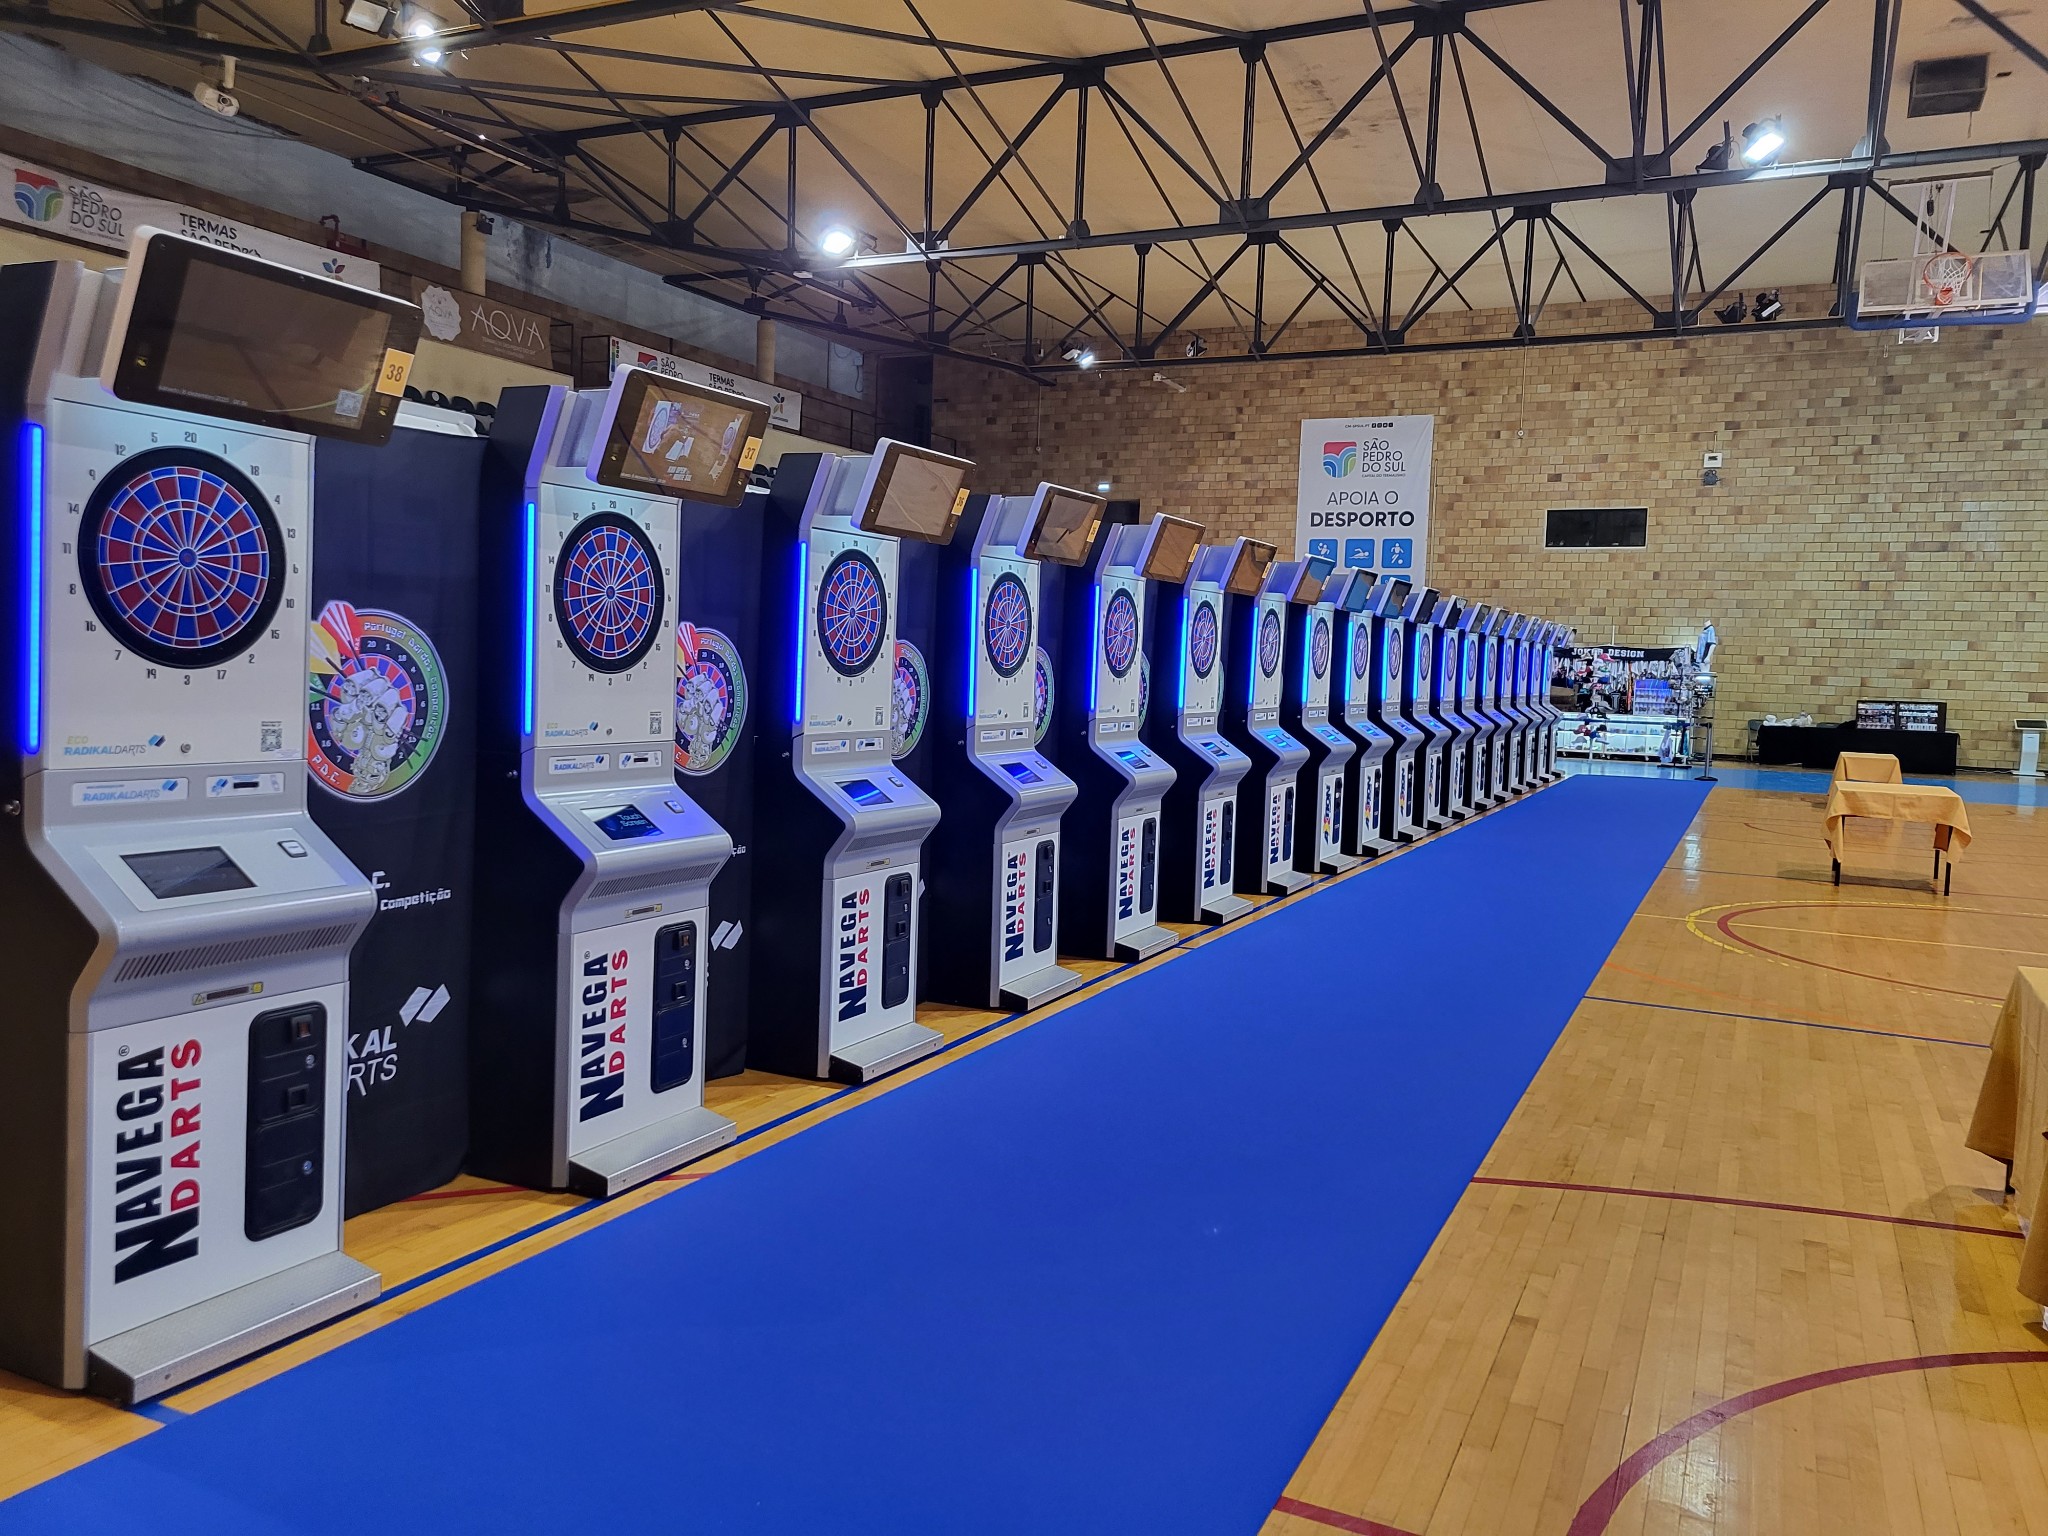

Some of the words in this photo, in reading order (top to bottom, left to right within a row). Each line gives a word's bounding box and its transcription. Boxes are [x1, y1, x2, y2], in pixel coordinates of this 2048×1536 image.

[68, 185, 103, 203] SÃO
[72, 197, 122, 221] PEDRO
[70, 212, 96, 228] DO
[99, 219, 125, 237] SUL
[180, 212, 238, 239] TERMAS
[470, 304, 544, 350] AQVA
[661, 357, 676, 370] SÃO
[387, 364, 403, 382] 38
[709, 372, 735, 387] TERMAS
[151, 432, 158, 443] 5
[185, 431, 197, 443] 20
[115, 444, 126, 456] 12
[223, 444, 227, 454] 1
[1363, 438, 1389, 451] SÃO
[746, 448, 756, 459] 37
[1363, 451, 1403, 462] PEDRO
[250, 465, 259, 476] 18
[1362, 462, 1381, 473] DO
[1384, 461, 1406, 473] SUL
[89, 469, 95, 480] 9
[274, 495, 280, 504] 4
[1327, 491, 1379, 505] APOIA
[1384, 490, 1399, 505] O
[68, 503, 79, 514] 14
[592, 502, 595, 510] 5
[609, 500, 616, 509] 20
[573, 512, 579, 521] 12
[630, 508, 633, 516] 1
[1310, 511, 1415, 527] DESPORTO
[287, 528, 296, 538] 13
[559, 531, 563, 539] 9
[62, 543, 71, 554] 11
[548, 556, 554, 564] 14
[293, 564, 298, 574] 6
[665, 568, 670, 576] 13
[69, 584, 76, 594] 8
[545, 584, 550, 593] 11
[286, 598, 294, 608] 10
[549, 614, 552, 622] 8
[85, 621, 96, 632] 16
[664, 620, 669, 628] 10
[271, 629, 280, 639] 15
[367, 640, 376, 648] 20
[115, 650, 121, 660] 7
[1608, 649, 1645, 657] DESIGN
[249, 654, 255, 664] 2
[572, 660, 576, 668] 7
[146, 669, 156, 679] 19
[217, 670, 227, 679] 17
[184, 675, 190, 685] 3
[608, 678, 612, 686] 3
[545, 726, 589, 737] RADIKALDARTS
[67, 736, 88, 744] ECO
[64, 745, 146, 756] RADIKALDARTS
[554, 761, 595, 771] RADIKALDARTS
[82, 789, 160, 802] RADIKALDARTS
[618, 812, 643, 821] Touch
[620, 818, 648, 827] Screen
[732, 844, 746, 857] ção
[1204, 810, 1214, 889] NAVEGA
[1128, 827, 1136, 896] DARTS
[371, 870, 391, 889] C.
[1119, 829, 1132, 920] NAVEGA
[1017, 852, 1026, 933] DARTS
[380, 887, 451, 912] Competição
[1005, 854, 1024, 962] NAVEGA
[857, 888, 870, 986] DARTS
[838, 891, 867, 1022] NAVEGA
[609, 949, 628, 1073] DARTS
[347, 1025, 397, 1059] KAL
[579, 953, 624, 1123] NAVEGA
[347, 1053, 398, 1096] RTS
[171, 1039, 202, 1211] DARTS
[115, 1046, 199, 1285] NAVEGA
